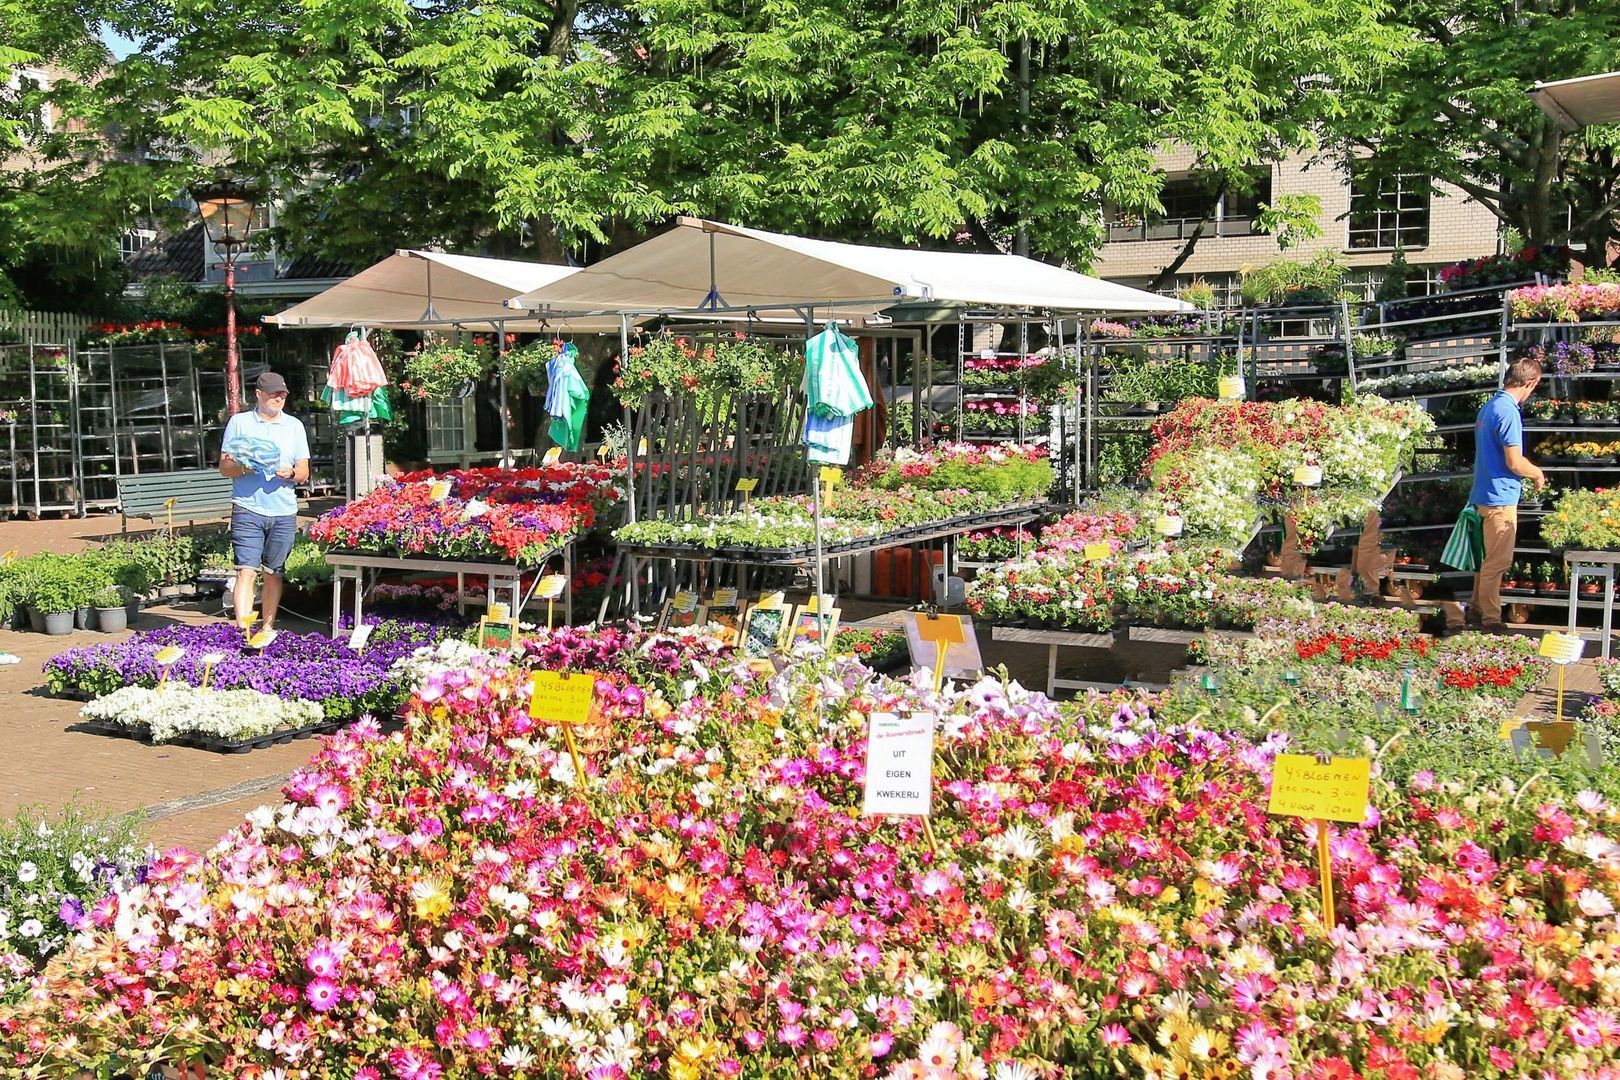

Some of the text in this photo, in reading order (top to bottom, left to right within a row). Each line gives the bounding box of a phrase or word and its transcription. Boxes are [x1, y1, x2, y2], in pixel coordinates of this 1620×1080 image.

[892, 750, 907, 758] UIT
[885, 770, 911, 778] EIGEN
[1285, 766, 1361, 781] YSBLOEMEN
[876, 790, 920, 799] KWEKERIJ
